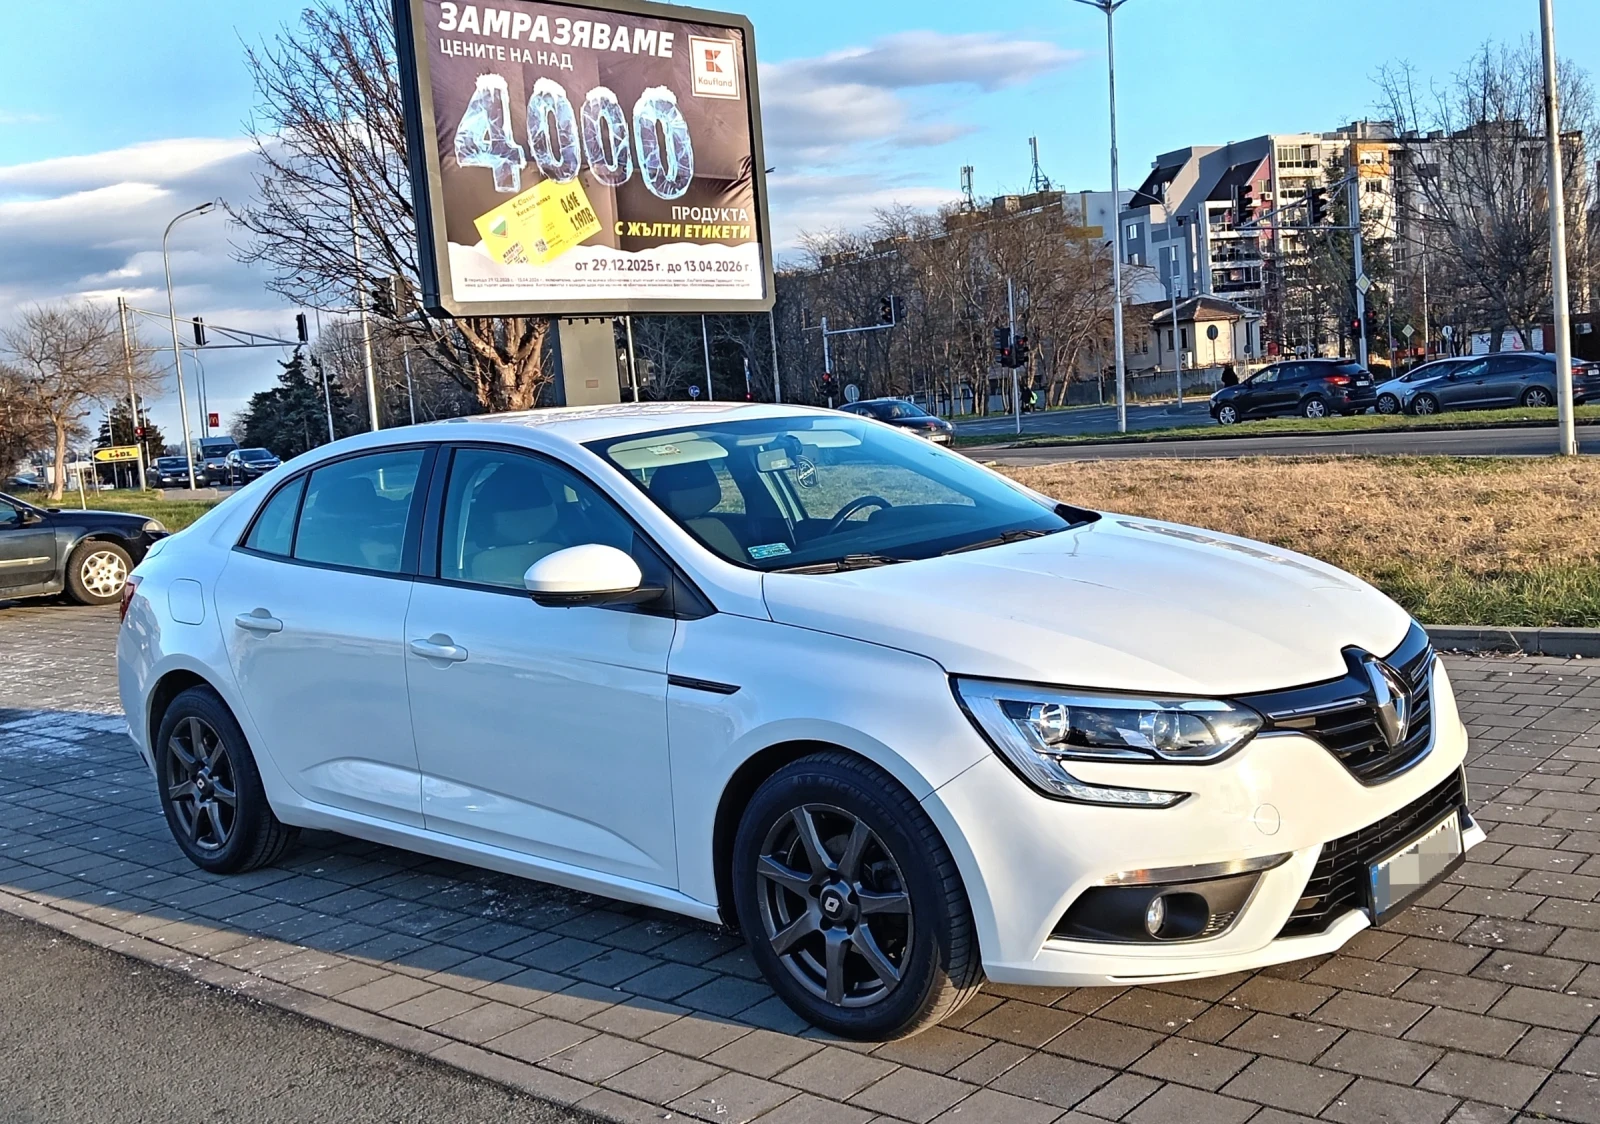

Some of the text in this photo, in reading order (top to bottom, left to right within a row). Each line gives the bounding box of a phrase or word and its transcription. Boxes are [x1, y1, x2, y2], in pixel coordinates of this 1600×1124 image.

[437, 1, 675, 58] ЗАМРАЗЯВАМЕ
[439, 38, 574, 71] ЦЕНИТЕ НА НАД
[698, 76, 733, 87] Kaufland
[454, 73, 694, 201] 4000
[671, 206, 749, 223] ПРОДУКТА
[614, 221, 750, 239] С ЖЪЛТИ ЕТИКЕТИ
[575, 262, 588, 271] от
[592, 259, 654, 272] 29.12.2025
[667, 263, 682, 274] до
[684, 260, 743, 273] 13.04.2026
